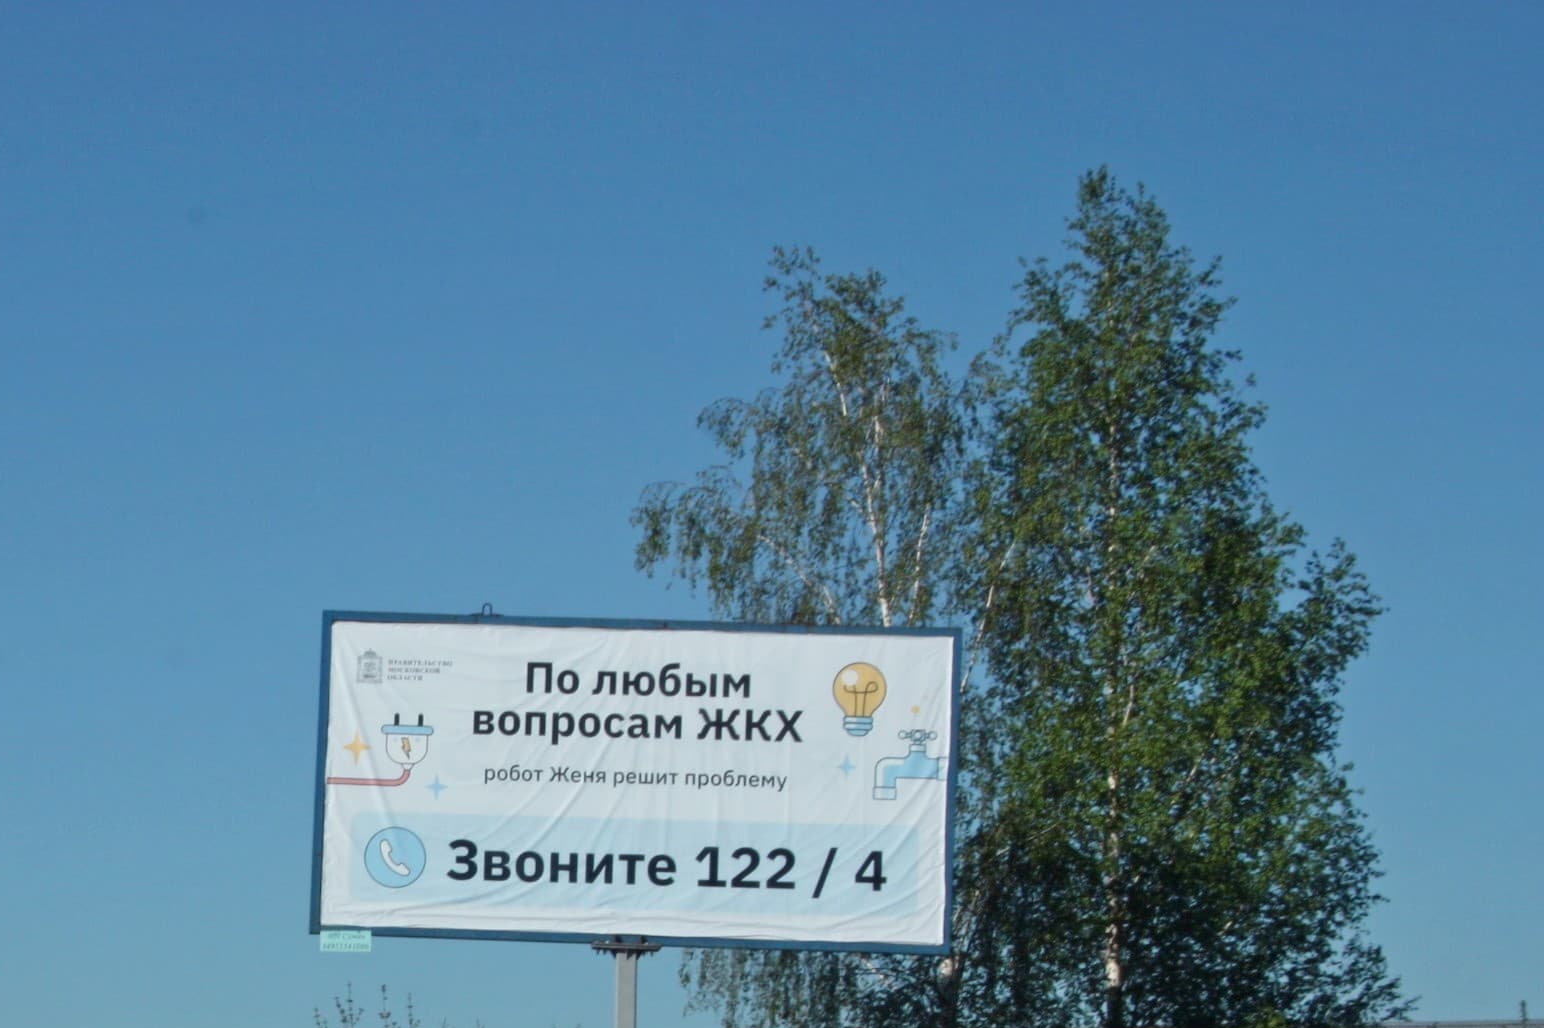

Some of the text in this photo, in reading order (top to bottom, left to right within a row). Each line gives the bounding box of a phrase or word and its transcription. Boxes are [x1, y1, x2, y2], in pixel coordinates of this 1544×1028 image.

[525, 661, 752, 699] По любым
[472, 707, 804, 746] вопросам ЖКХ
[484, 764, 788, 792] робот Женя решит проблему
[446, 838, 888, 899] Звоните 122 / 4
